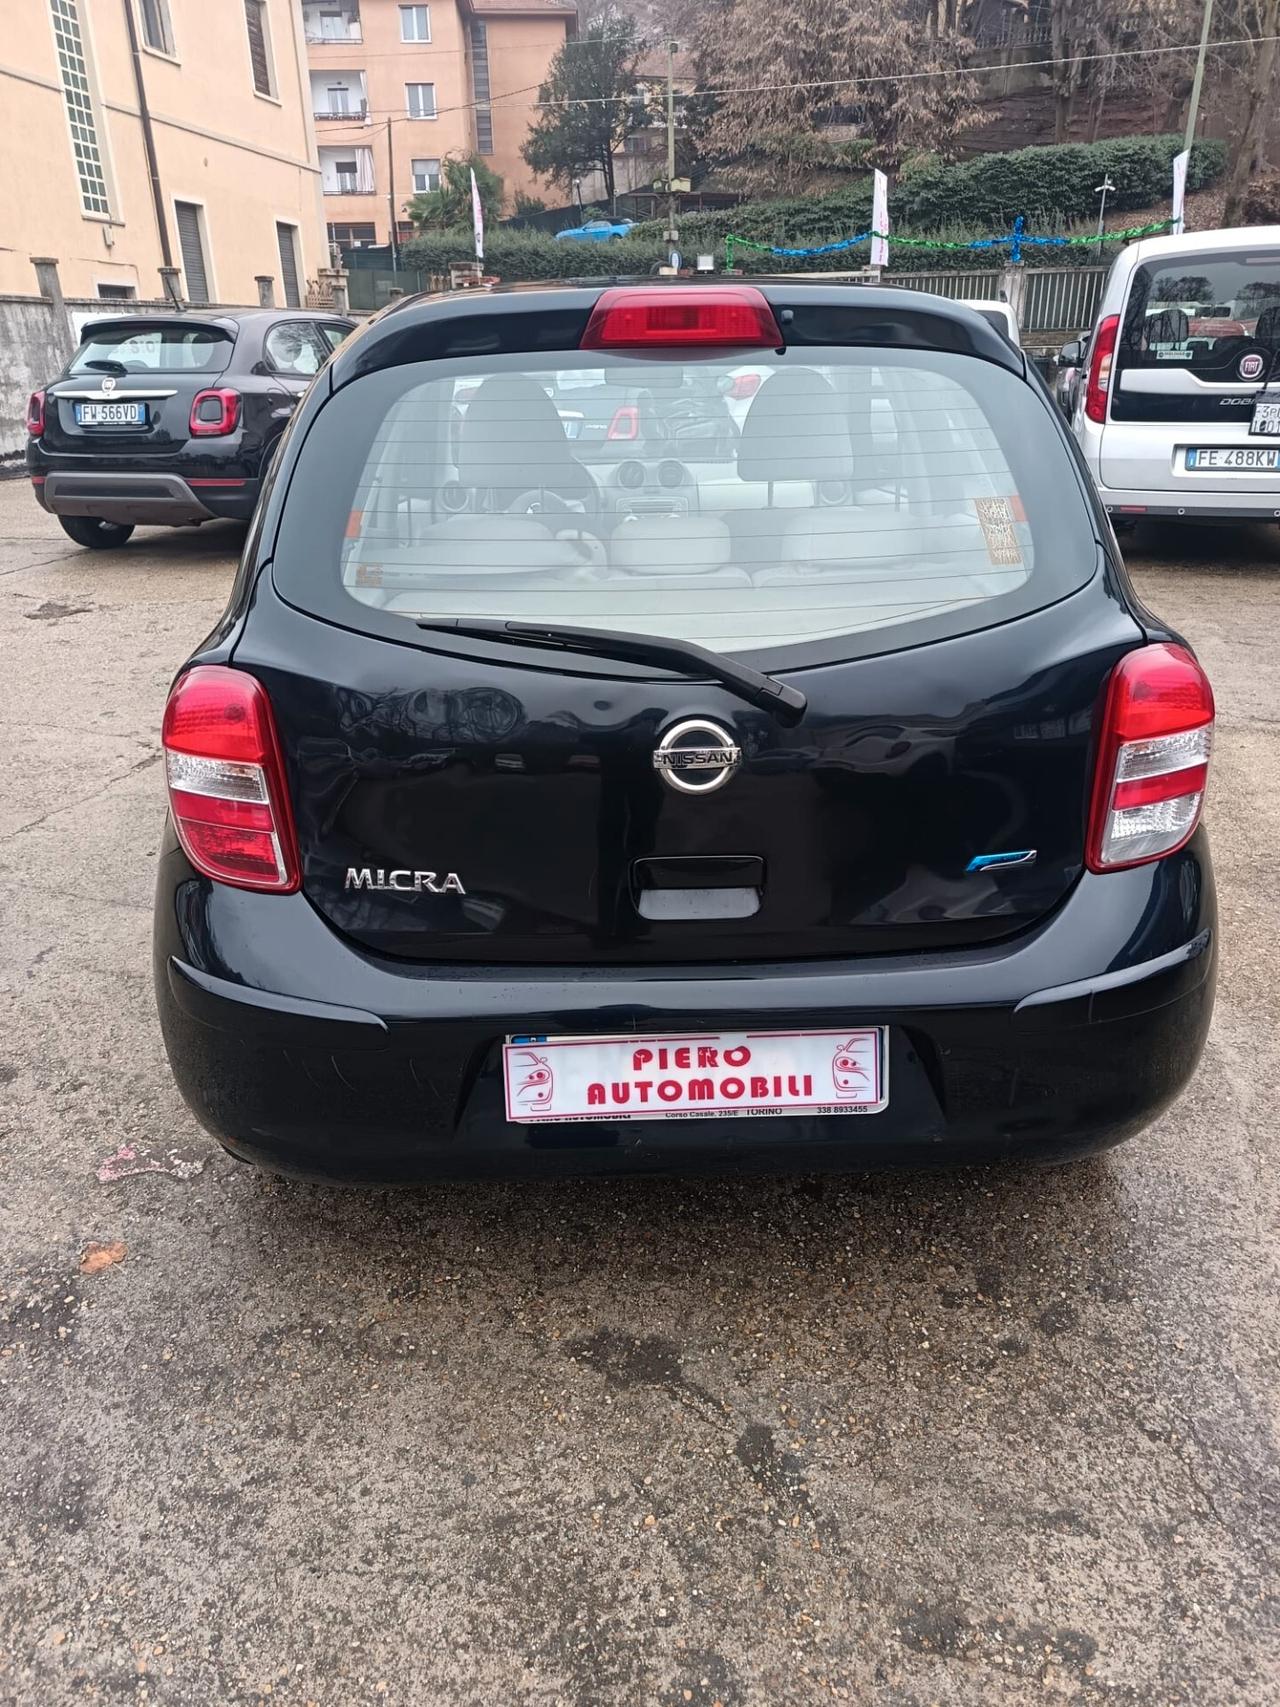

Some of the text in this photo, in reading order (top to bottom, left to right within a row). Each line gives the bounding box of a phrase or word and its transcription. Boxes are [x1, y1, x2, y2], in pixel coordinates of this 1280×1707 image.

[1244, 361, 1259, 372] FIAT
[83, 405, 137, 420] FW 566VD
[1198, 450, 1276, 466] FE 488KW
[662, 751, 733, 765] NISSAN
[344, 867, 466, 895] MICRA
[632, 1045, 751, 1071] PIERO
[587, 1074, 813, 1105] AUTOMOBILI
[745, 1107, 783, 1116] TORINO
[817, 1106, 832, 1114] 338
[833, 1105, 868, 1113] 8933455
